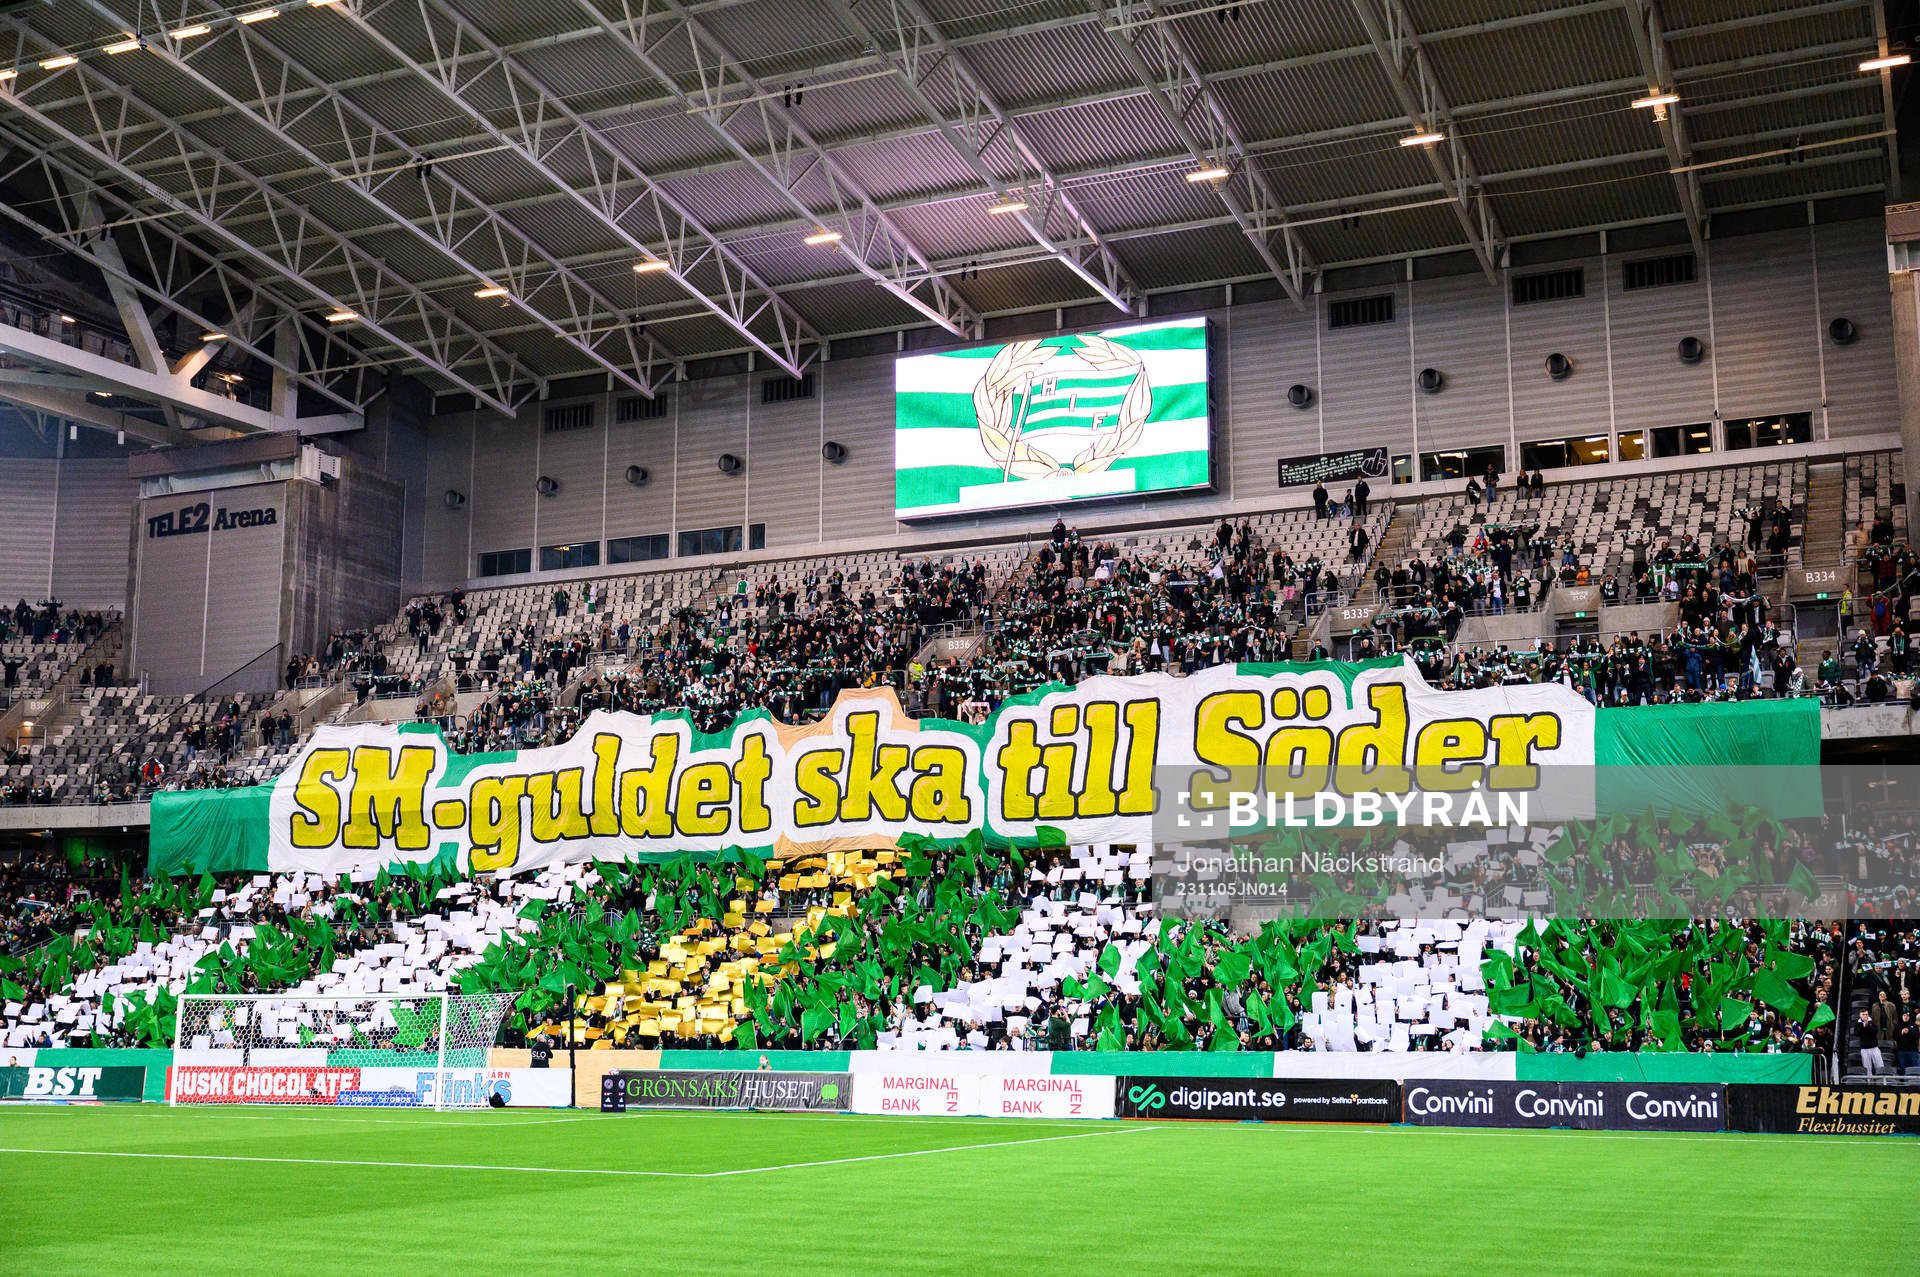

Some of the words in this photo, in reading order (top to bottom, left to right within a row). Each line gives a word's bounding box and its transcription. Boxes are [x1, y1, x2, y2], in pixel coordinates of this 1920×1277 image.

[148, 503, 210, 538] TELE2
[213, 507, 277, 530] Arena
[1806, 571, 1836, 583] B334
[1343, 608, 1369, 619] B335
[948, 640, 970, 650] B336
[290, 732, 772, 872] SM-guldet
[794, 711, 972, 828] ska
[999, 698, 1160, 822] till
[1187, 682, 1562, 812] Söder
[24, 1067, 102, 1096] BST
[175, 1072, 228, 1096] HUSKI
[232, 1072, 354, 1098] CHOCOLATE
[416, 1071, 512, 1104] Finks
[626, 1075, 737, 1098] GRÖNSAKS
[744, 1080, 814, 1099] HUSET
[882, 1098, 920, 1111] BANK
[1002, 1100, 1042, 1113] BANK
[1170, 1086, 1286, 1110] digipant.se
[1293, 1097, 1321, 1105] powered
[1322, 1097, 1331, 1105] by
[1408, 1087, 1494, 1115] Convini
[1515, 1089, 1603, 1118] Convini
[1626, 1091, 1718, 1119] Convini
[1796, 1086, 1920, 1116] Ekman
[1797, 1117, 1896, 1134] Flexibussitet
